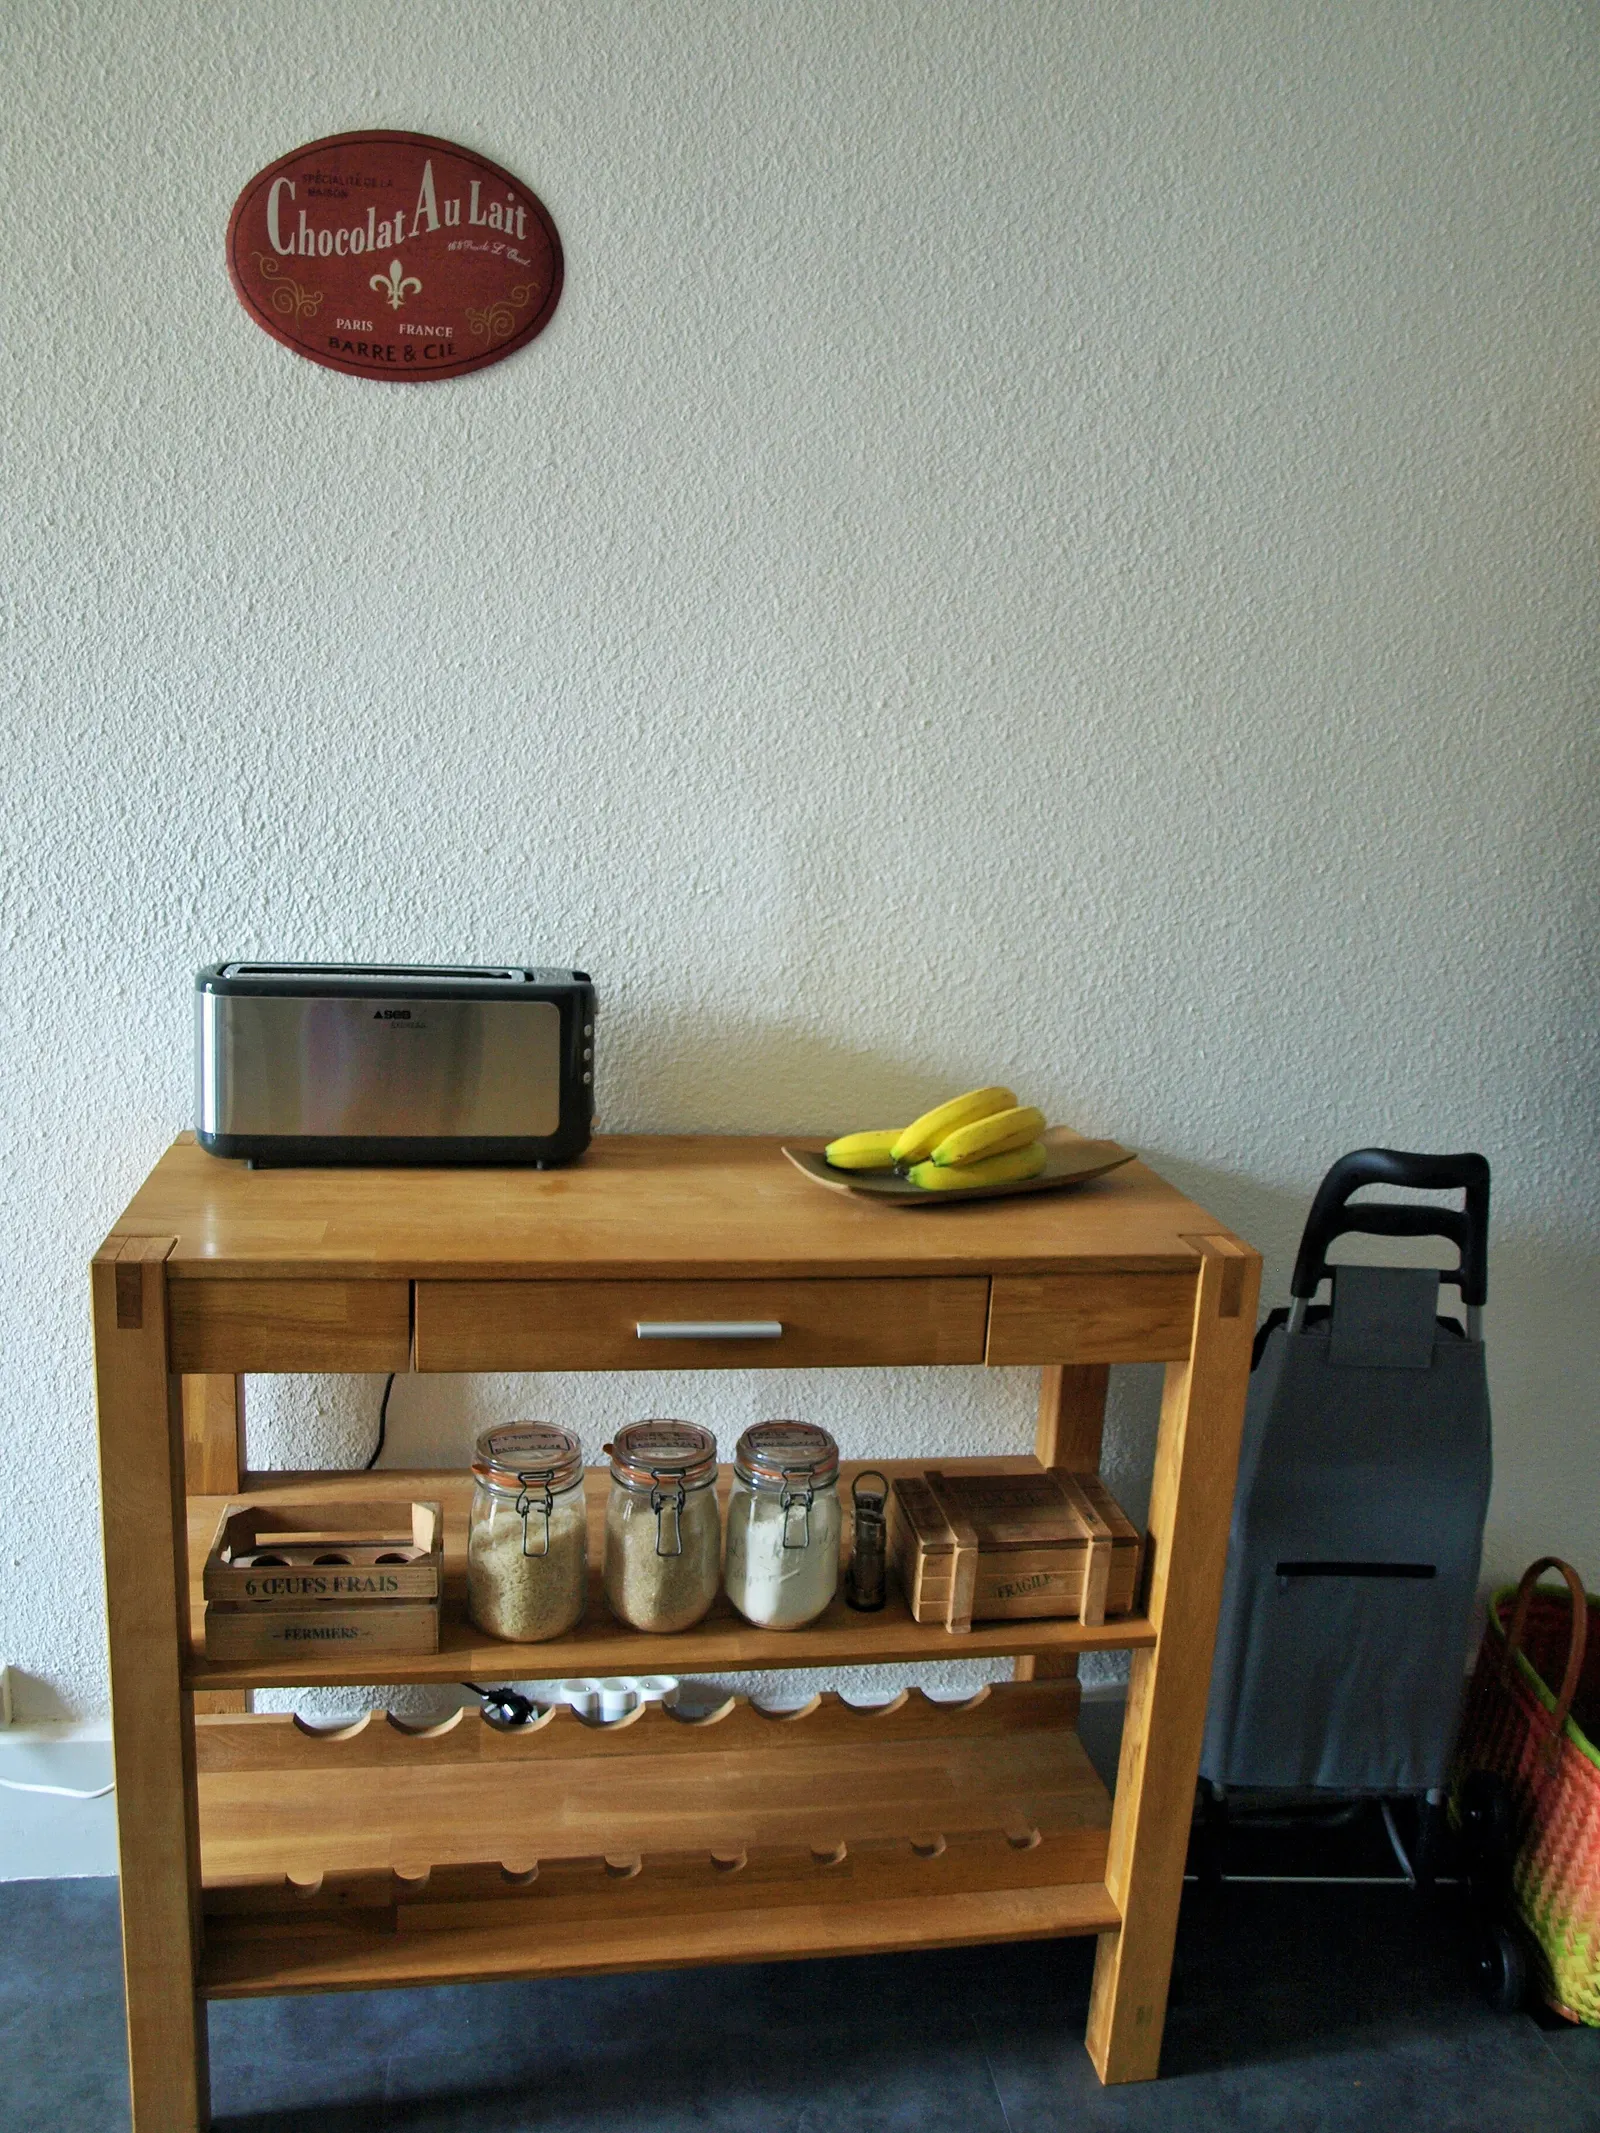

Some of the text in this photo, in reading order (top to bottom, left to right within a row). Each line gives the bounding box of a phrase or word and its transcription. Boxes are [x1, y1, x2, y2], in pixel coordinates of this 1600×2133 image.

[266, 159, 527, 257] Chocolat Au Lait
[336, 318, 453, 338] PARIS FRANCE
[328, 336, 458, 362] BARRE & CIE
[245, 1575, 399, 1596] 6 ŒUFS FRAIS
[284, 1626, 360, 1641] FERMIERS
